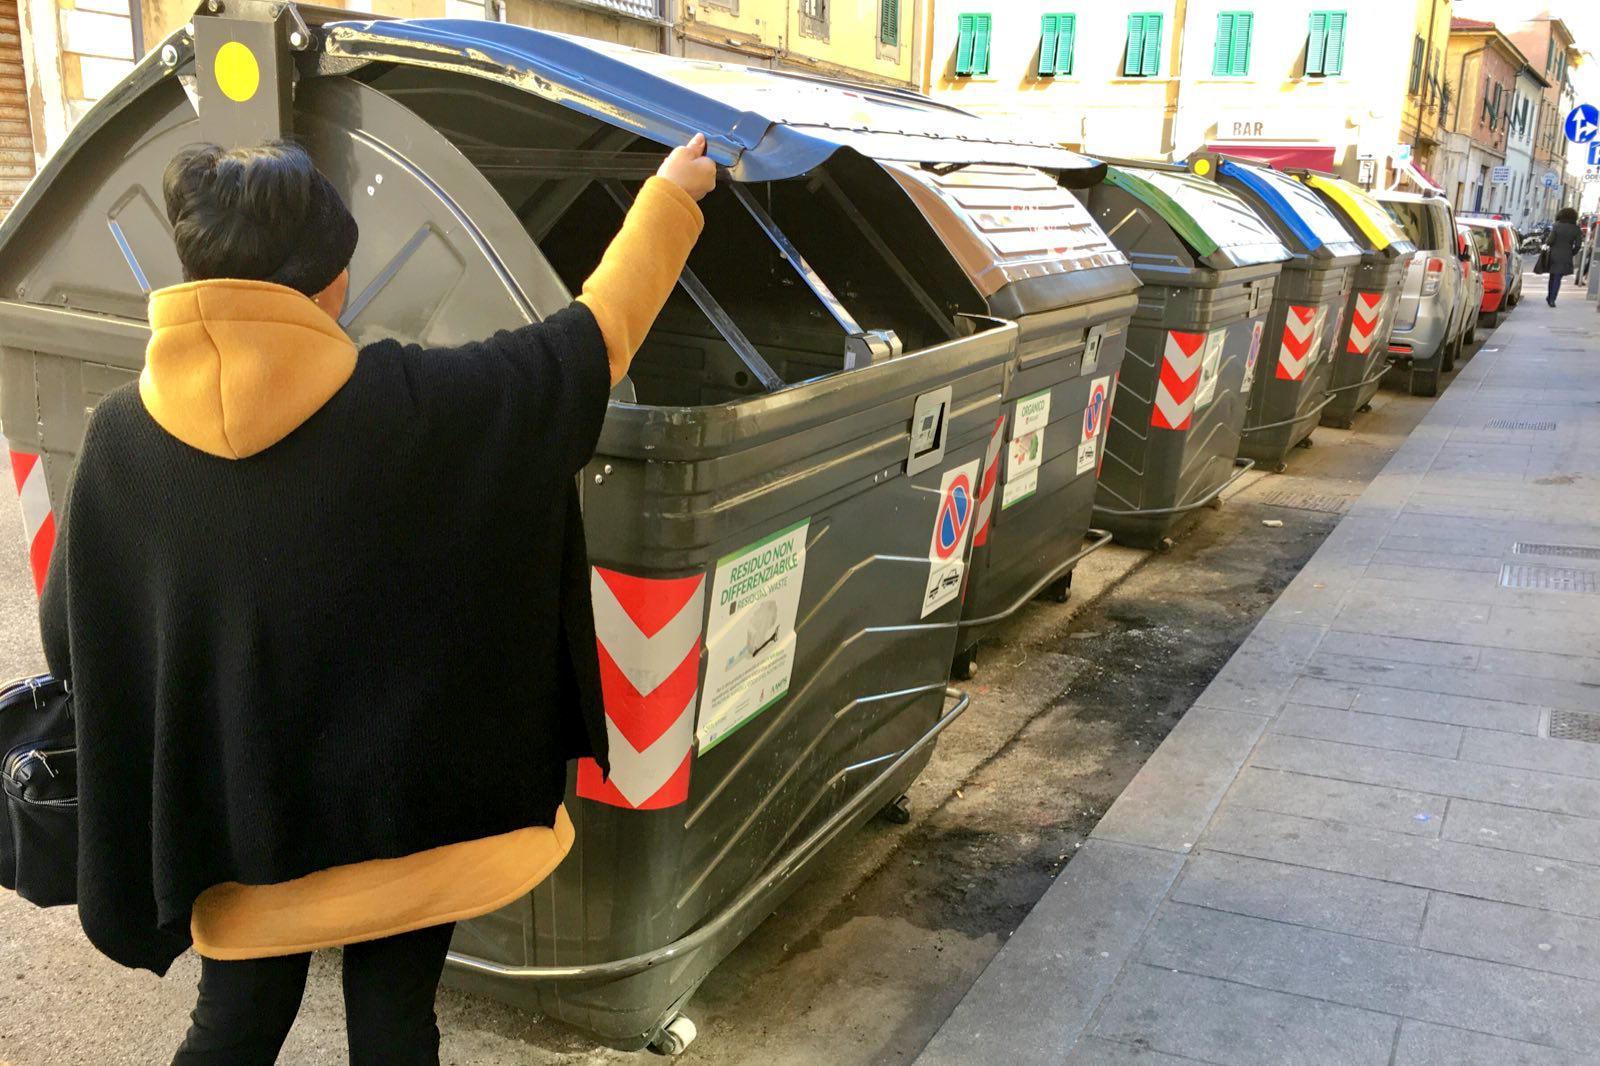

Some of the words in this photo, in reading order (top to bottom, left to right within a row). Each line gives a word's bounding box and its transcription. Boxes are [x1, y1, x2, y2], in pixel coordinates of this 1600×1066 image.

[1233, 121, 1264, 137] BAR
[1021, 400, 1045, 417] ORGANICO
[730, 550, 772, 583] RESIDUO
[772, 538, 794, 562] NON
[720, 552, 798, 607] DIFFERENZIABILE
[737, 586, 768, 610] RESIDUAL
